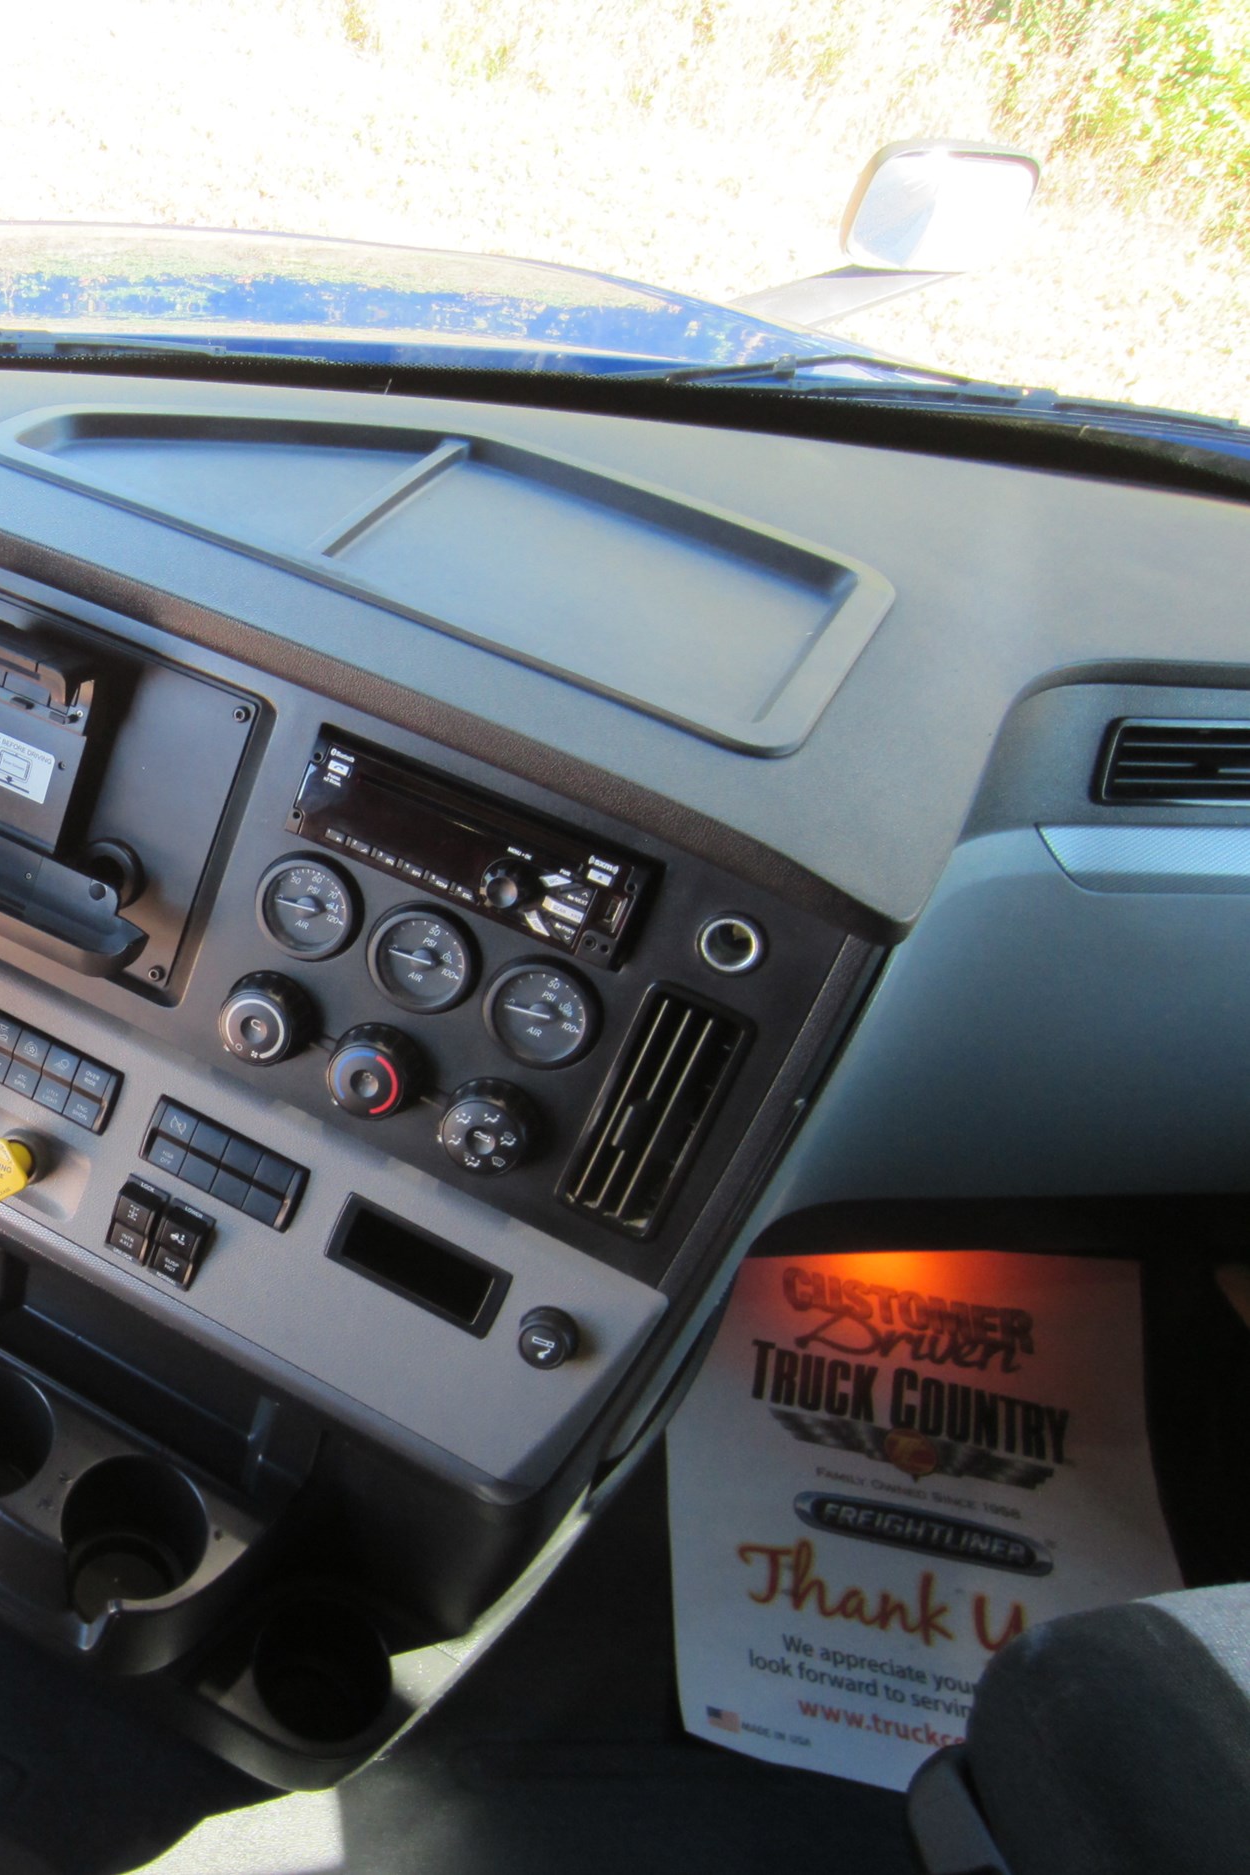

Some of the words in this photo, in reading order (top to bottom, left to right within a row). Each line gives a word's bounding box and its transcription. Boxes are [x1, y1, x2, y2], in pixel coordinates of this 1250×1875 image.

[2, 738, 26, 754] BEFORE
[27, 748, 52, 766] DRIVING
[290, 876, 302, 886] 50
[312, 874, 323, 884] 60
[306, 885, 321, 896] PSI
[328, 890, 339, 900] 70
[294, 920, 310, 931] AIR
[326, 914, 339, 925] 120
[428, 927, 440, 937] 50
[422, 938, 438, 948] PSI
[408, 972, 423, 983] AIR
[440, 968, 455, 980] 100
[548, 980, 560, 990] 50
[542, 990, 557, 1002] PSI
[526, 1026, 542, 1038] AIR
[562, 1022, 576, 1034] 100
[86, 1070, 100, 1081] OVER
[76, 1103, 88, 1113] ENG
[141, 1182, 155, 1194] LOCK
[184, 1206, 203, 1220] LOWER
[119, 1238, 133, 1250] AXLE
[782, 1266, 1035, 1355] CUSTOMER
[794, 1302, 1022, 1374] Driven
[751, 1339, 878, 1423] TRUCK
[890, 1367, 1070, 1465] COUNTRY
[816, 1466, 866, 1487] FAMILY
[870, 1479, 927, 1500] OWNED
[932, 1491, 976, 1510] SINCE
[824, 1502, 1026, 1564] FREIGHTLINER
[737, 1536, 954, 1648] Thank
[782, 1633, 815, 1657] We
[820, 1645, 927, 1685] appreciate
[749, 1648, 793, 1678] look
[798, 1662, 879, 1697] forward
[884, 1683, 906, 1704] to
[910, 1691, 971, 1719] servin
[741, 1722, 772, 1739] MADE
[774, 1730, 786, 1741] IN
[788, 1733, 812, 1748] USA
